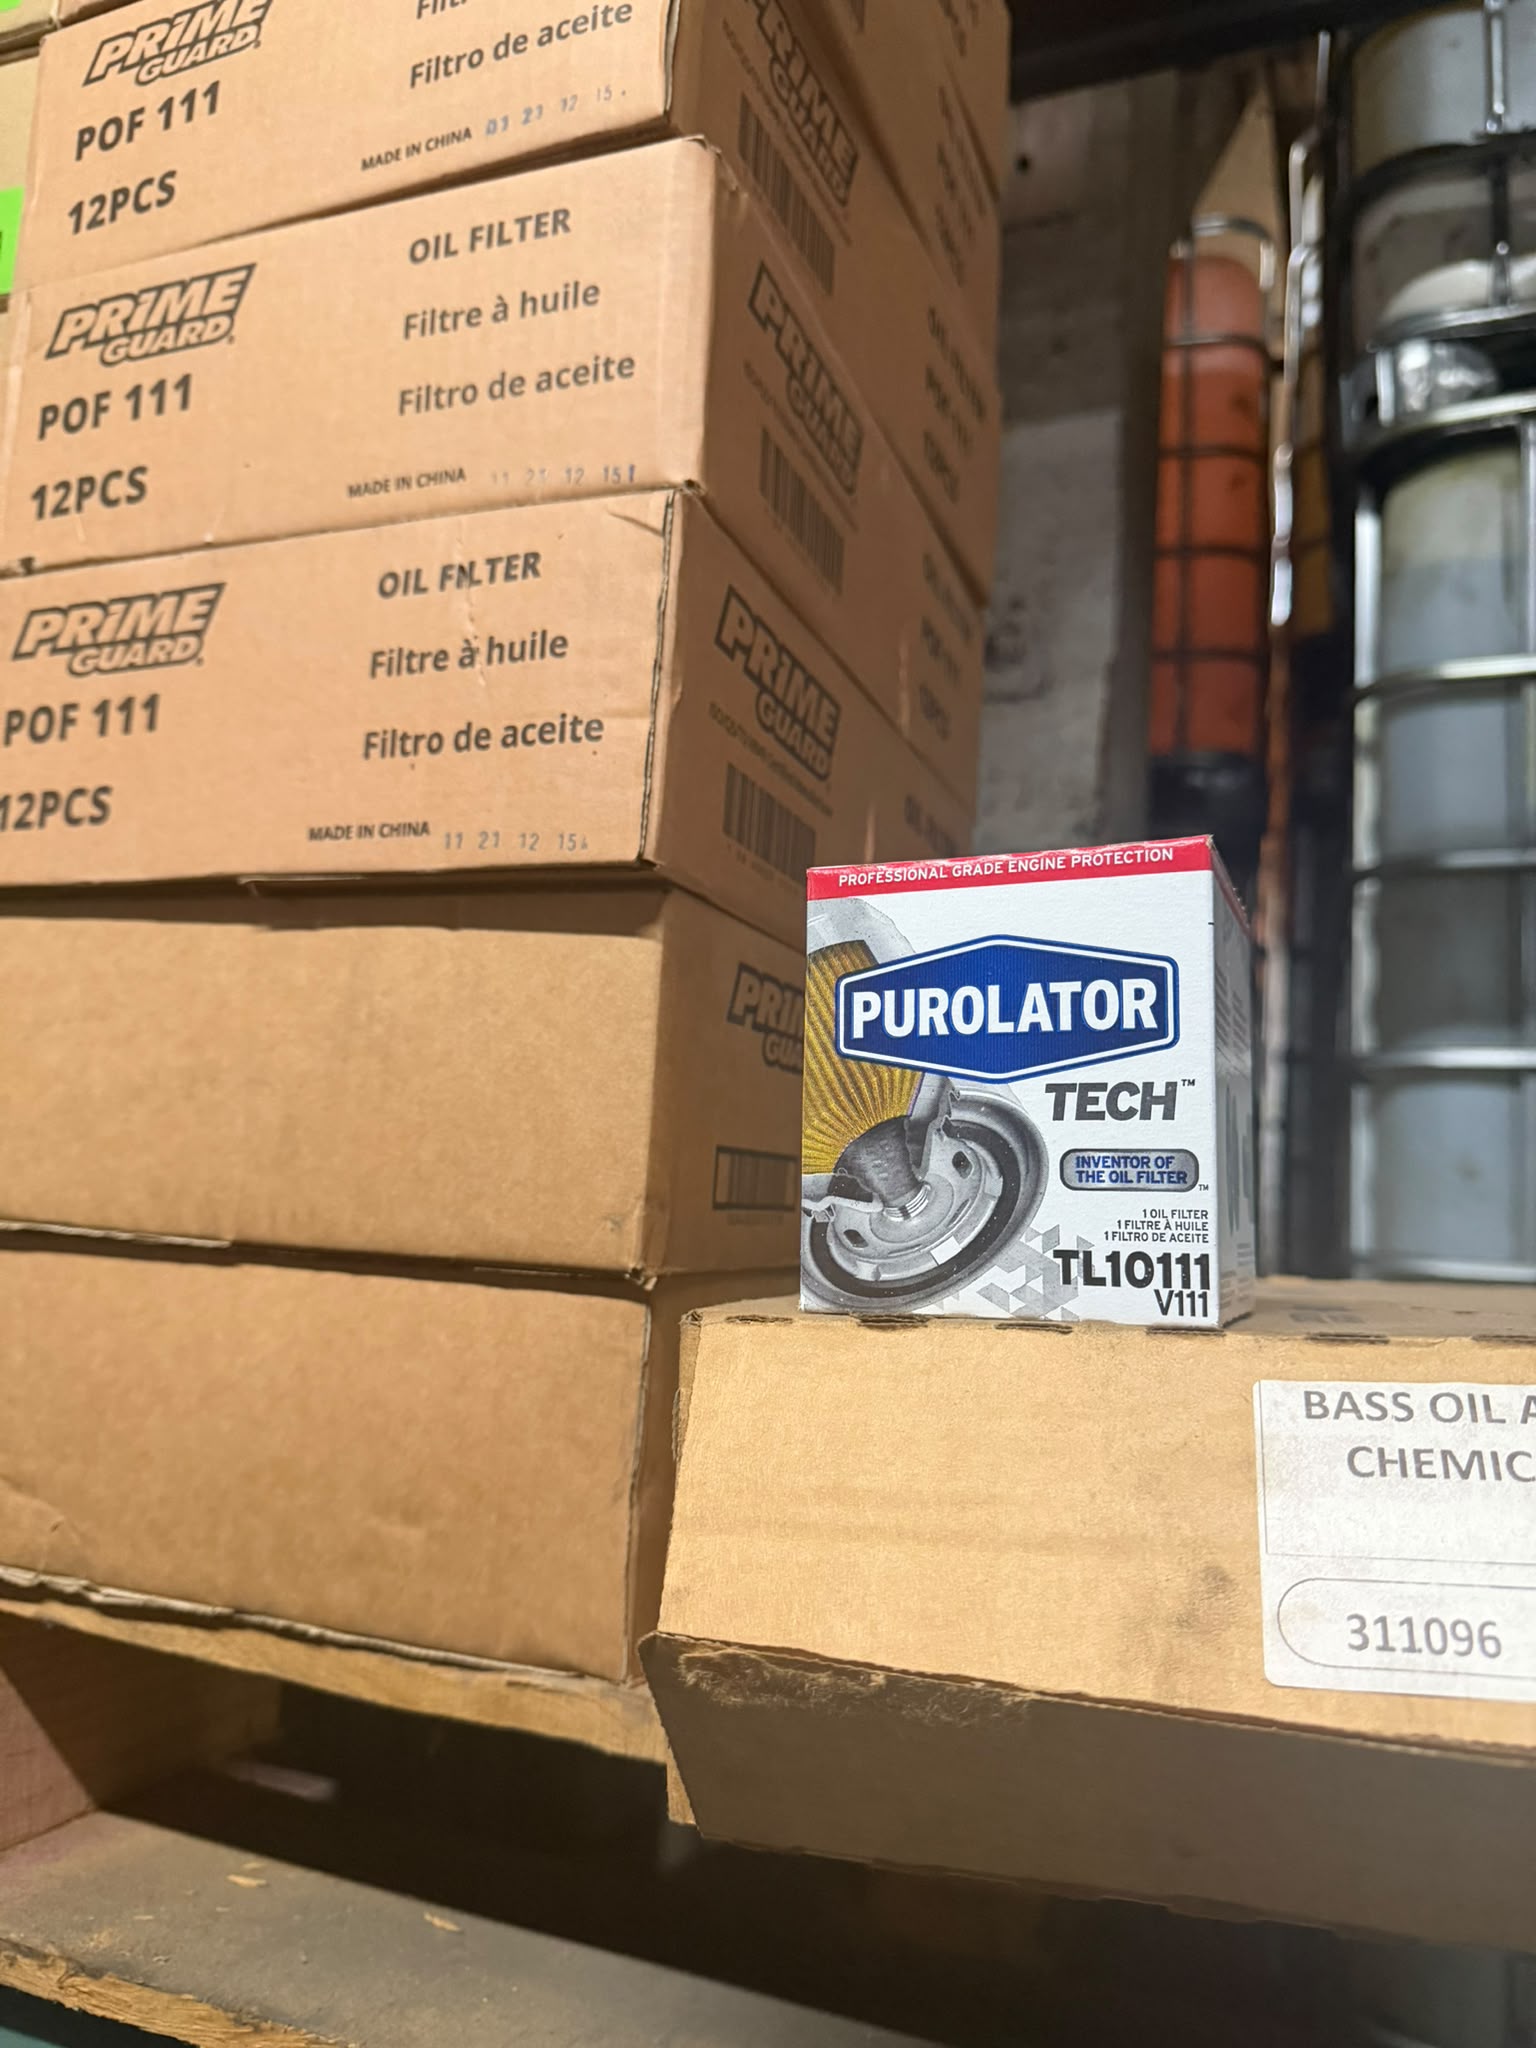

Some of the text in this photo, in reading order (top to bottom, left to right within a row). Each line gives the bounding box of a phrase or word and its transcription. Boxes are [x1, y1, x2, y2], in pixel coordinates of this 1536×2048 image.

[82, 0, 272, 87] PRIME
[135, 22, 262, 86] GUARD
[410, 3, 632, 89] Filtro de aceite
[75, 80, 220, 162] POF 111
[361, 148, 401, 171] MADE
[405, 142, 421, 158] IN
[425, 127, 472, 152] CHINA
[68, 170, 177, 235] 12PCS
[408, 208, 571, 265] OIL FILTER
[45, 263, 257, 360] PRIME
[403, 280, 600, 341] Filtre à huile
[100, 313, 234, 368] GUARD
[398, 355, 635, 416] Filtro de aceite
[748, 260, 864, 473] PRIME
[38, 373, 192, 441] POF 111
[31, 465, 148, 520] 12PCS
[347, 479, 391, 498] MADE
[395, 475, 413, 491] IN
[416, 467, 466, 489] CHINA
[378, 552, 541, 599] OIL FILTER
[11, 582, 227, 661] PRIME
[67, 633, 203, 678] GUARD
[369, 629, 568, 679] Filtre à huile
[714, 583, 841, 751] PRIME
[3, 693, 160, 747] POF 111
[363, 712, 604, 760] Filtro de aceite
[755, 688, 834, 782] GUARD
[0, 785, 113, 833] 12PCS
[309, 825, 353, 841] MADE
[357, 824, 375, 838] IN
[379, 821, 430, 838] CHINA
[478, 830, 500, 850] 21
[519, 832, 541, 851] 12
[838, 847, 1174, 888] PROFESSIONAL GRADE ENGINE PROTECTION
[851, 977, 1158, 1039] PUROLATOR
[1045, 1081, 1178, 1121] TECH
[1076, 1155, 1175, 1169] INVENTOR OF
[1076, 1170, 1105, 1184] THE
[1109, 1170, 1133, 1184] OIL
[1136, 1171, 1187, 1184] FILTER
[1104, 1231, 1209, 1243] 1 FILTRO DE ACEITE
[1117, 1218, 1208, 1231] 1 FILTRE À HUILE
[1142, 1209, 1208, 1220] 1 OIL FILTER
[1053, 1249, 1210, 1290] TL10111
[1154, 1289, 1208, 1317] V111
[1303, 1390, 1415, 1422] BASS
[1428, 1391, 1506, 1424] OIL
[1346, 1446, 1536, 1482] CHEMIC
[1346, 1613, 1501, 1659] 311096
